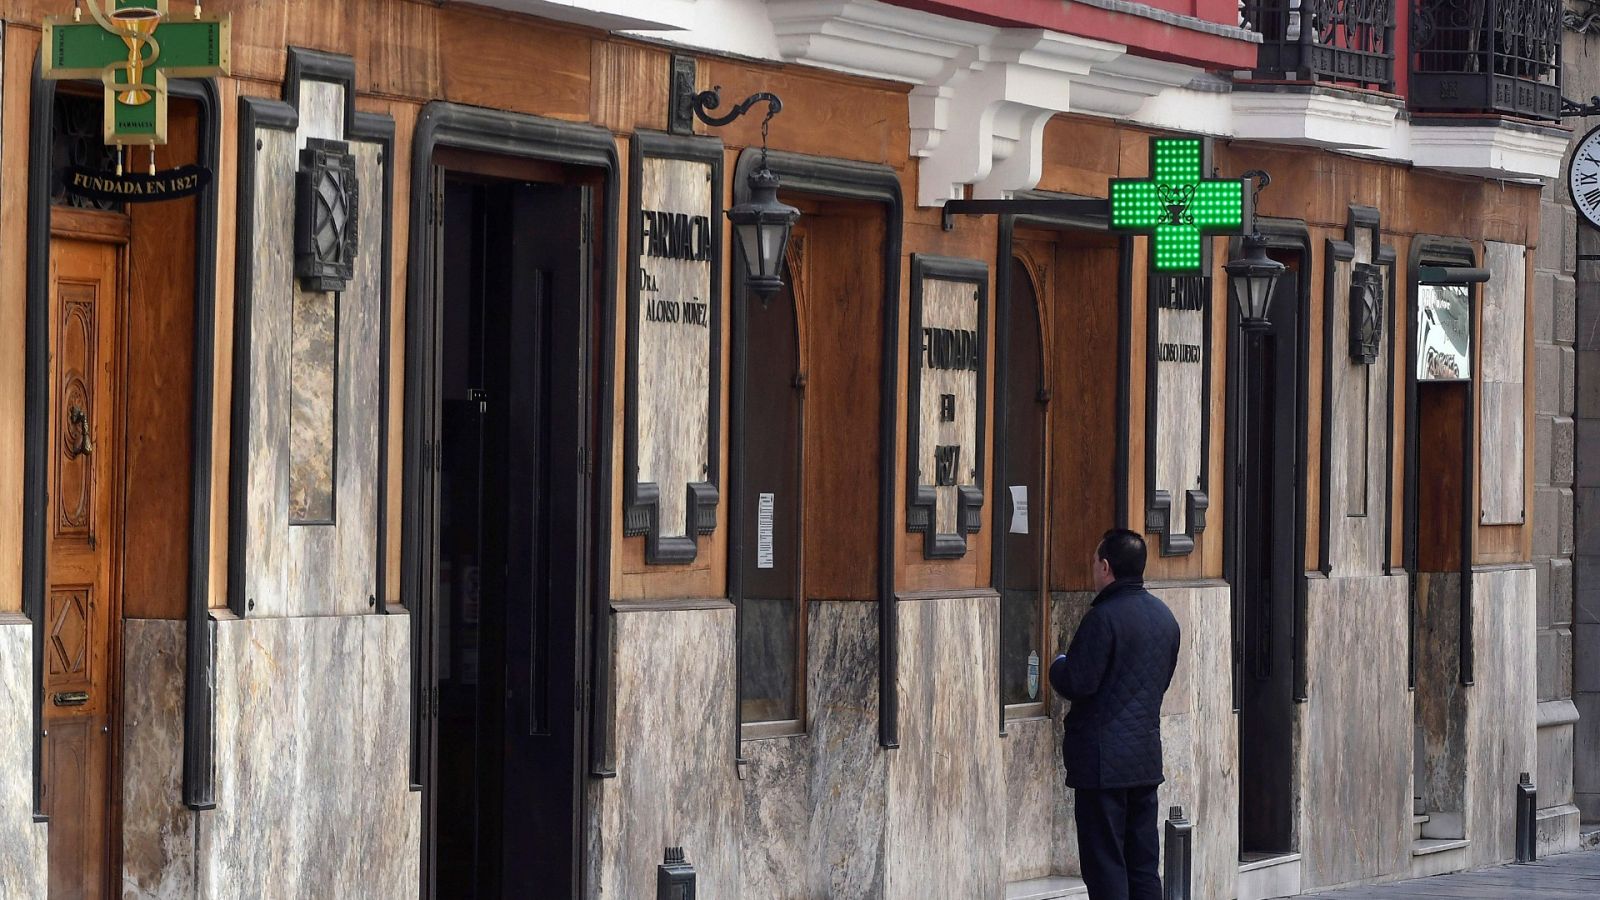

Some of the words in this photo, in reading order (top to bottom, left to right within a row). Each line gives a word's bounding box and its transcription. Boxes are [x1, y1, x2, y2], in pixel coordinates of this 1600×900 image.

[73, 173, 143, 194] FUNDADA
[146, 181, 166, 194] EN
[171, 174, 198, 192] 1827
[640, 210, 711, 261] FARMACIA
[645, 299, 680, 323] ALONSO
